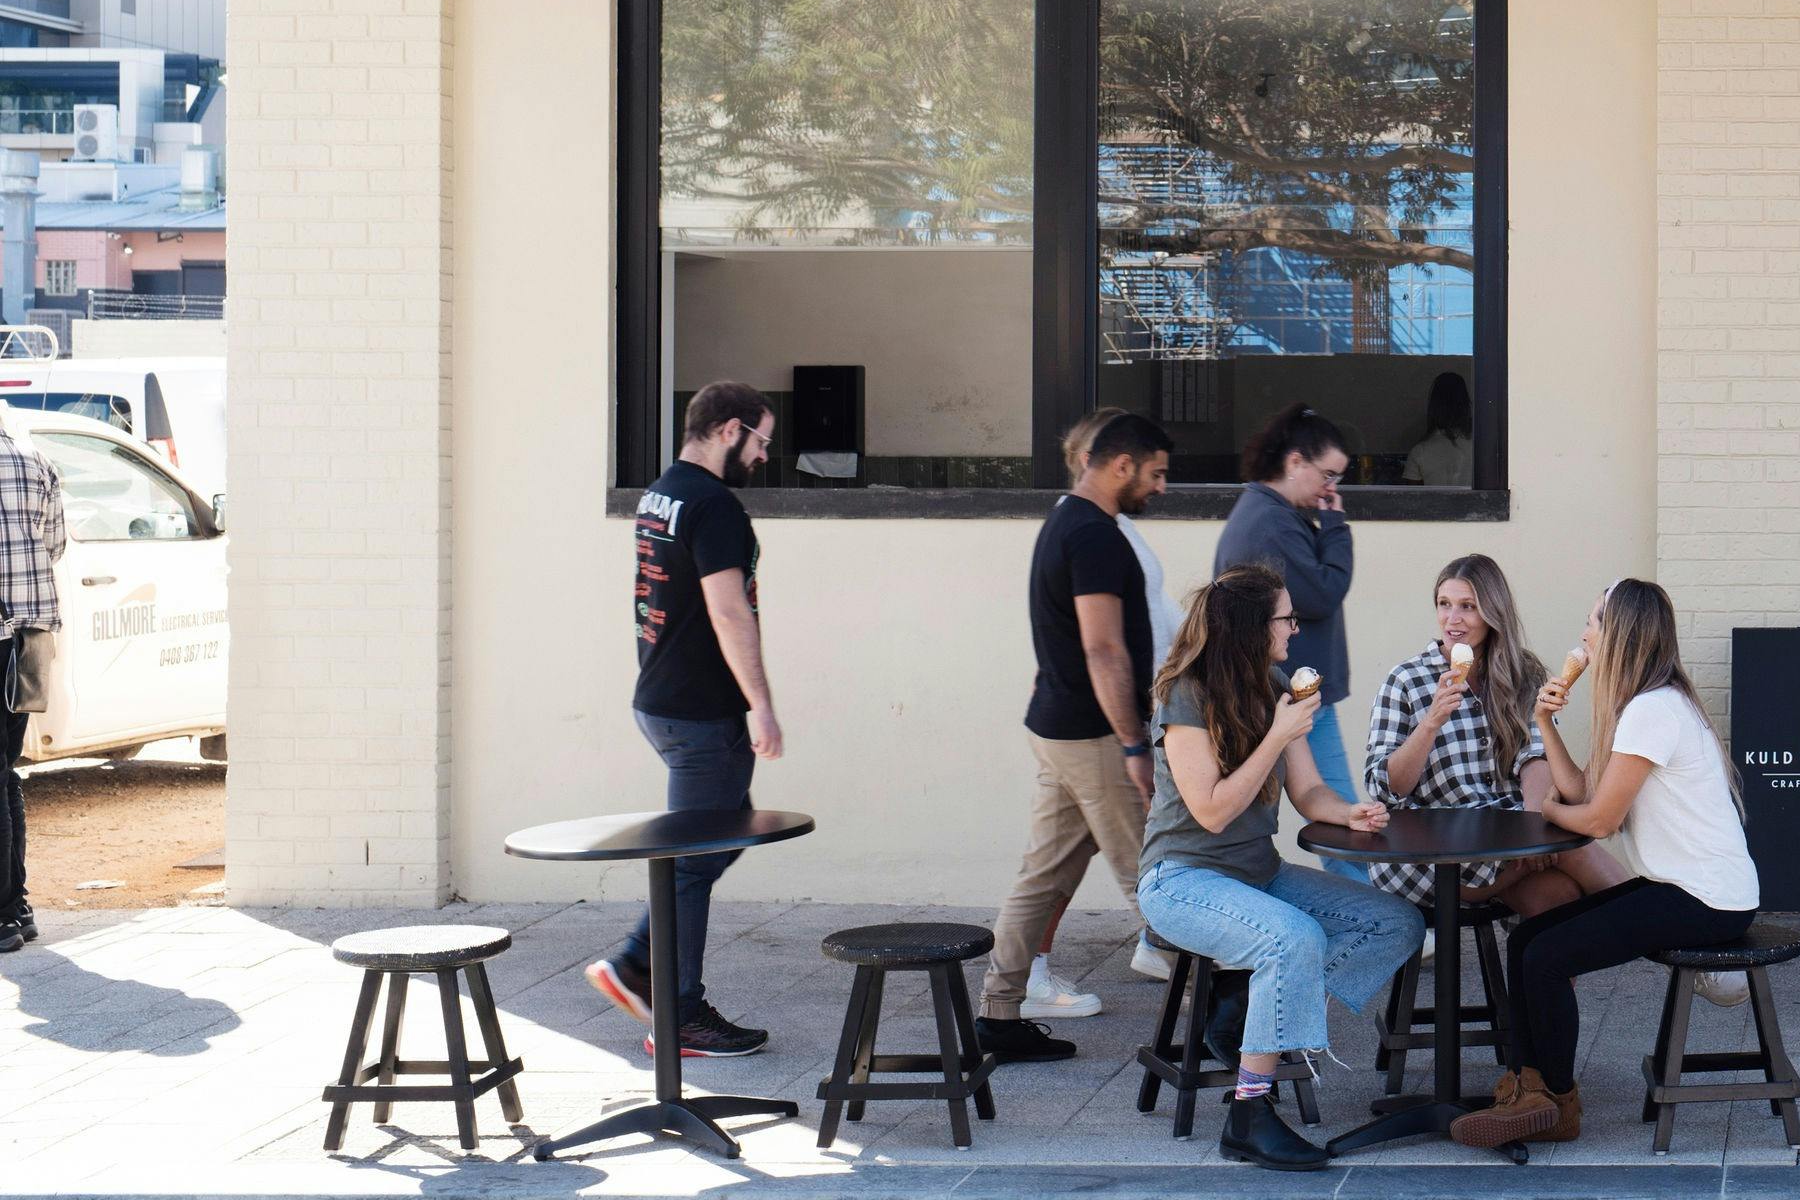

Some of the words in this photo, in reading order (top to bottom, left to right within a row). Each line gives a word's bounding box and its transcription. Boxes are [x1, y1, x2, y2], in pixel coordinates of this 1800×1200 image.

[92, 604, 156, 641] GILLMORE
[161, 613, 200, 632] ELECTRICAL
[203, 640, 219, 660] 122
[1745, 751, 1793, 765] KULD
